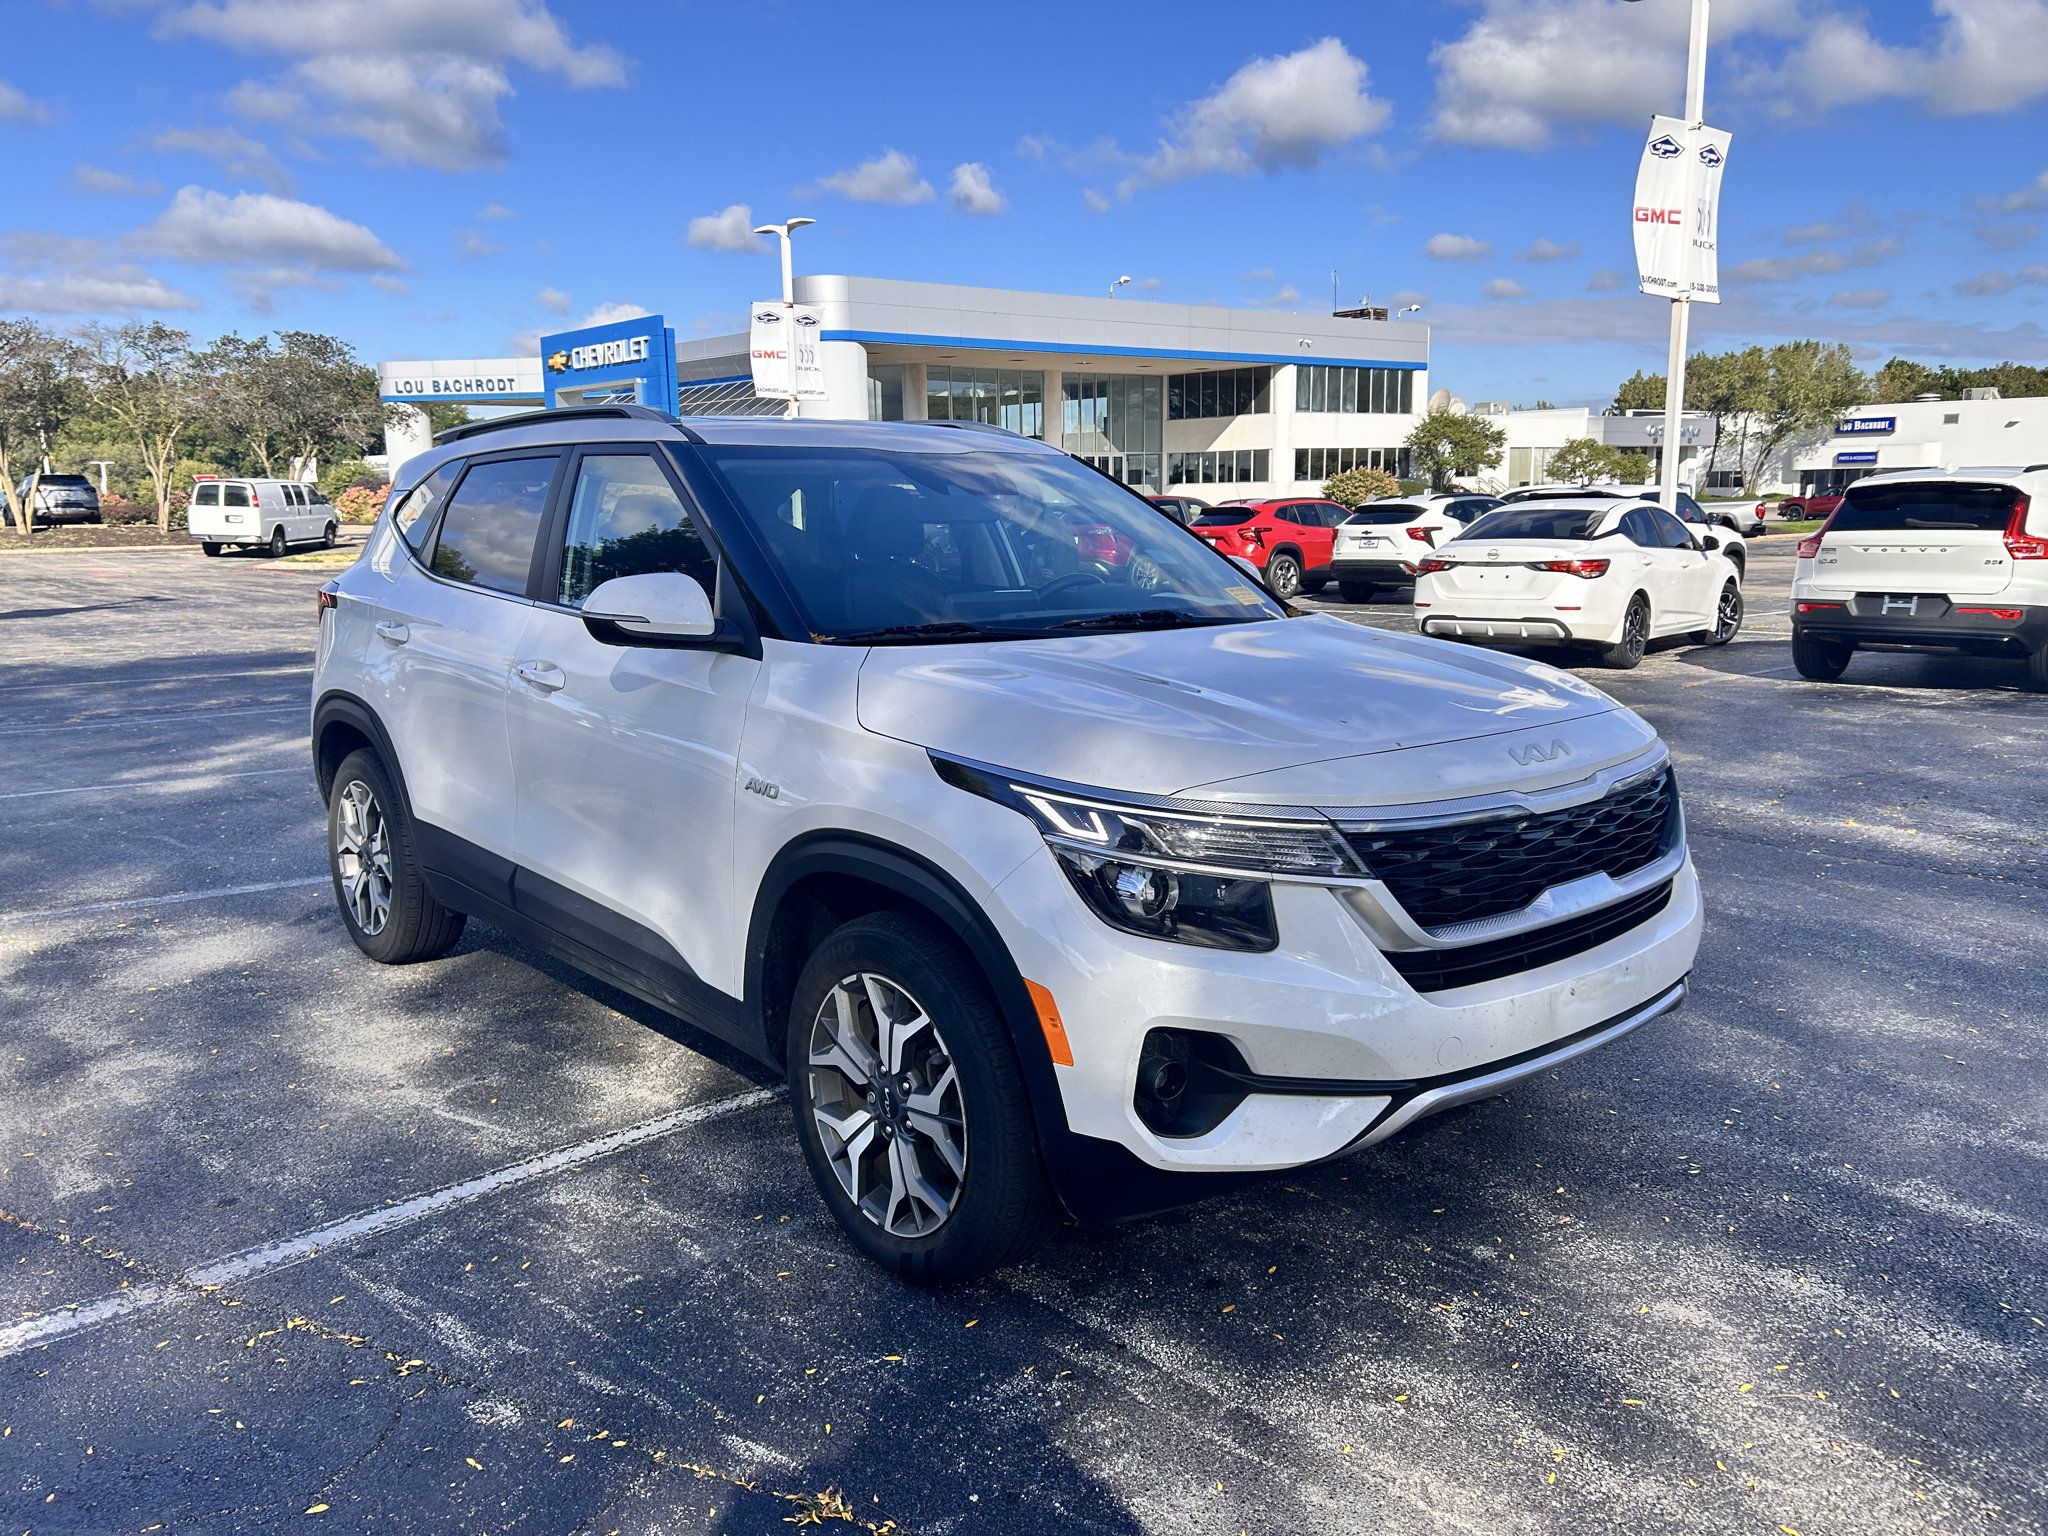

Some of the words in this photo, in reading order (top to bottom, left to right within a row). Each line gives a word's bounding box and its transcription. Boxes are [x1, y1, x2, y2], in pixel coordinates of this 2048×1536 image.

[1635, 206, 1681, 225] GMC
[571, 335, 650, 372] CHEVROLET
[752, 350, 787, 359] GMC
[395, 378, 424, 394] LOU
[432, 376, 517, 393] BACHRODT
[1508, 738, 1571, 767] KIA
[745, 778, 779, 799] AWD
